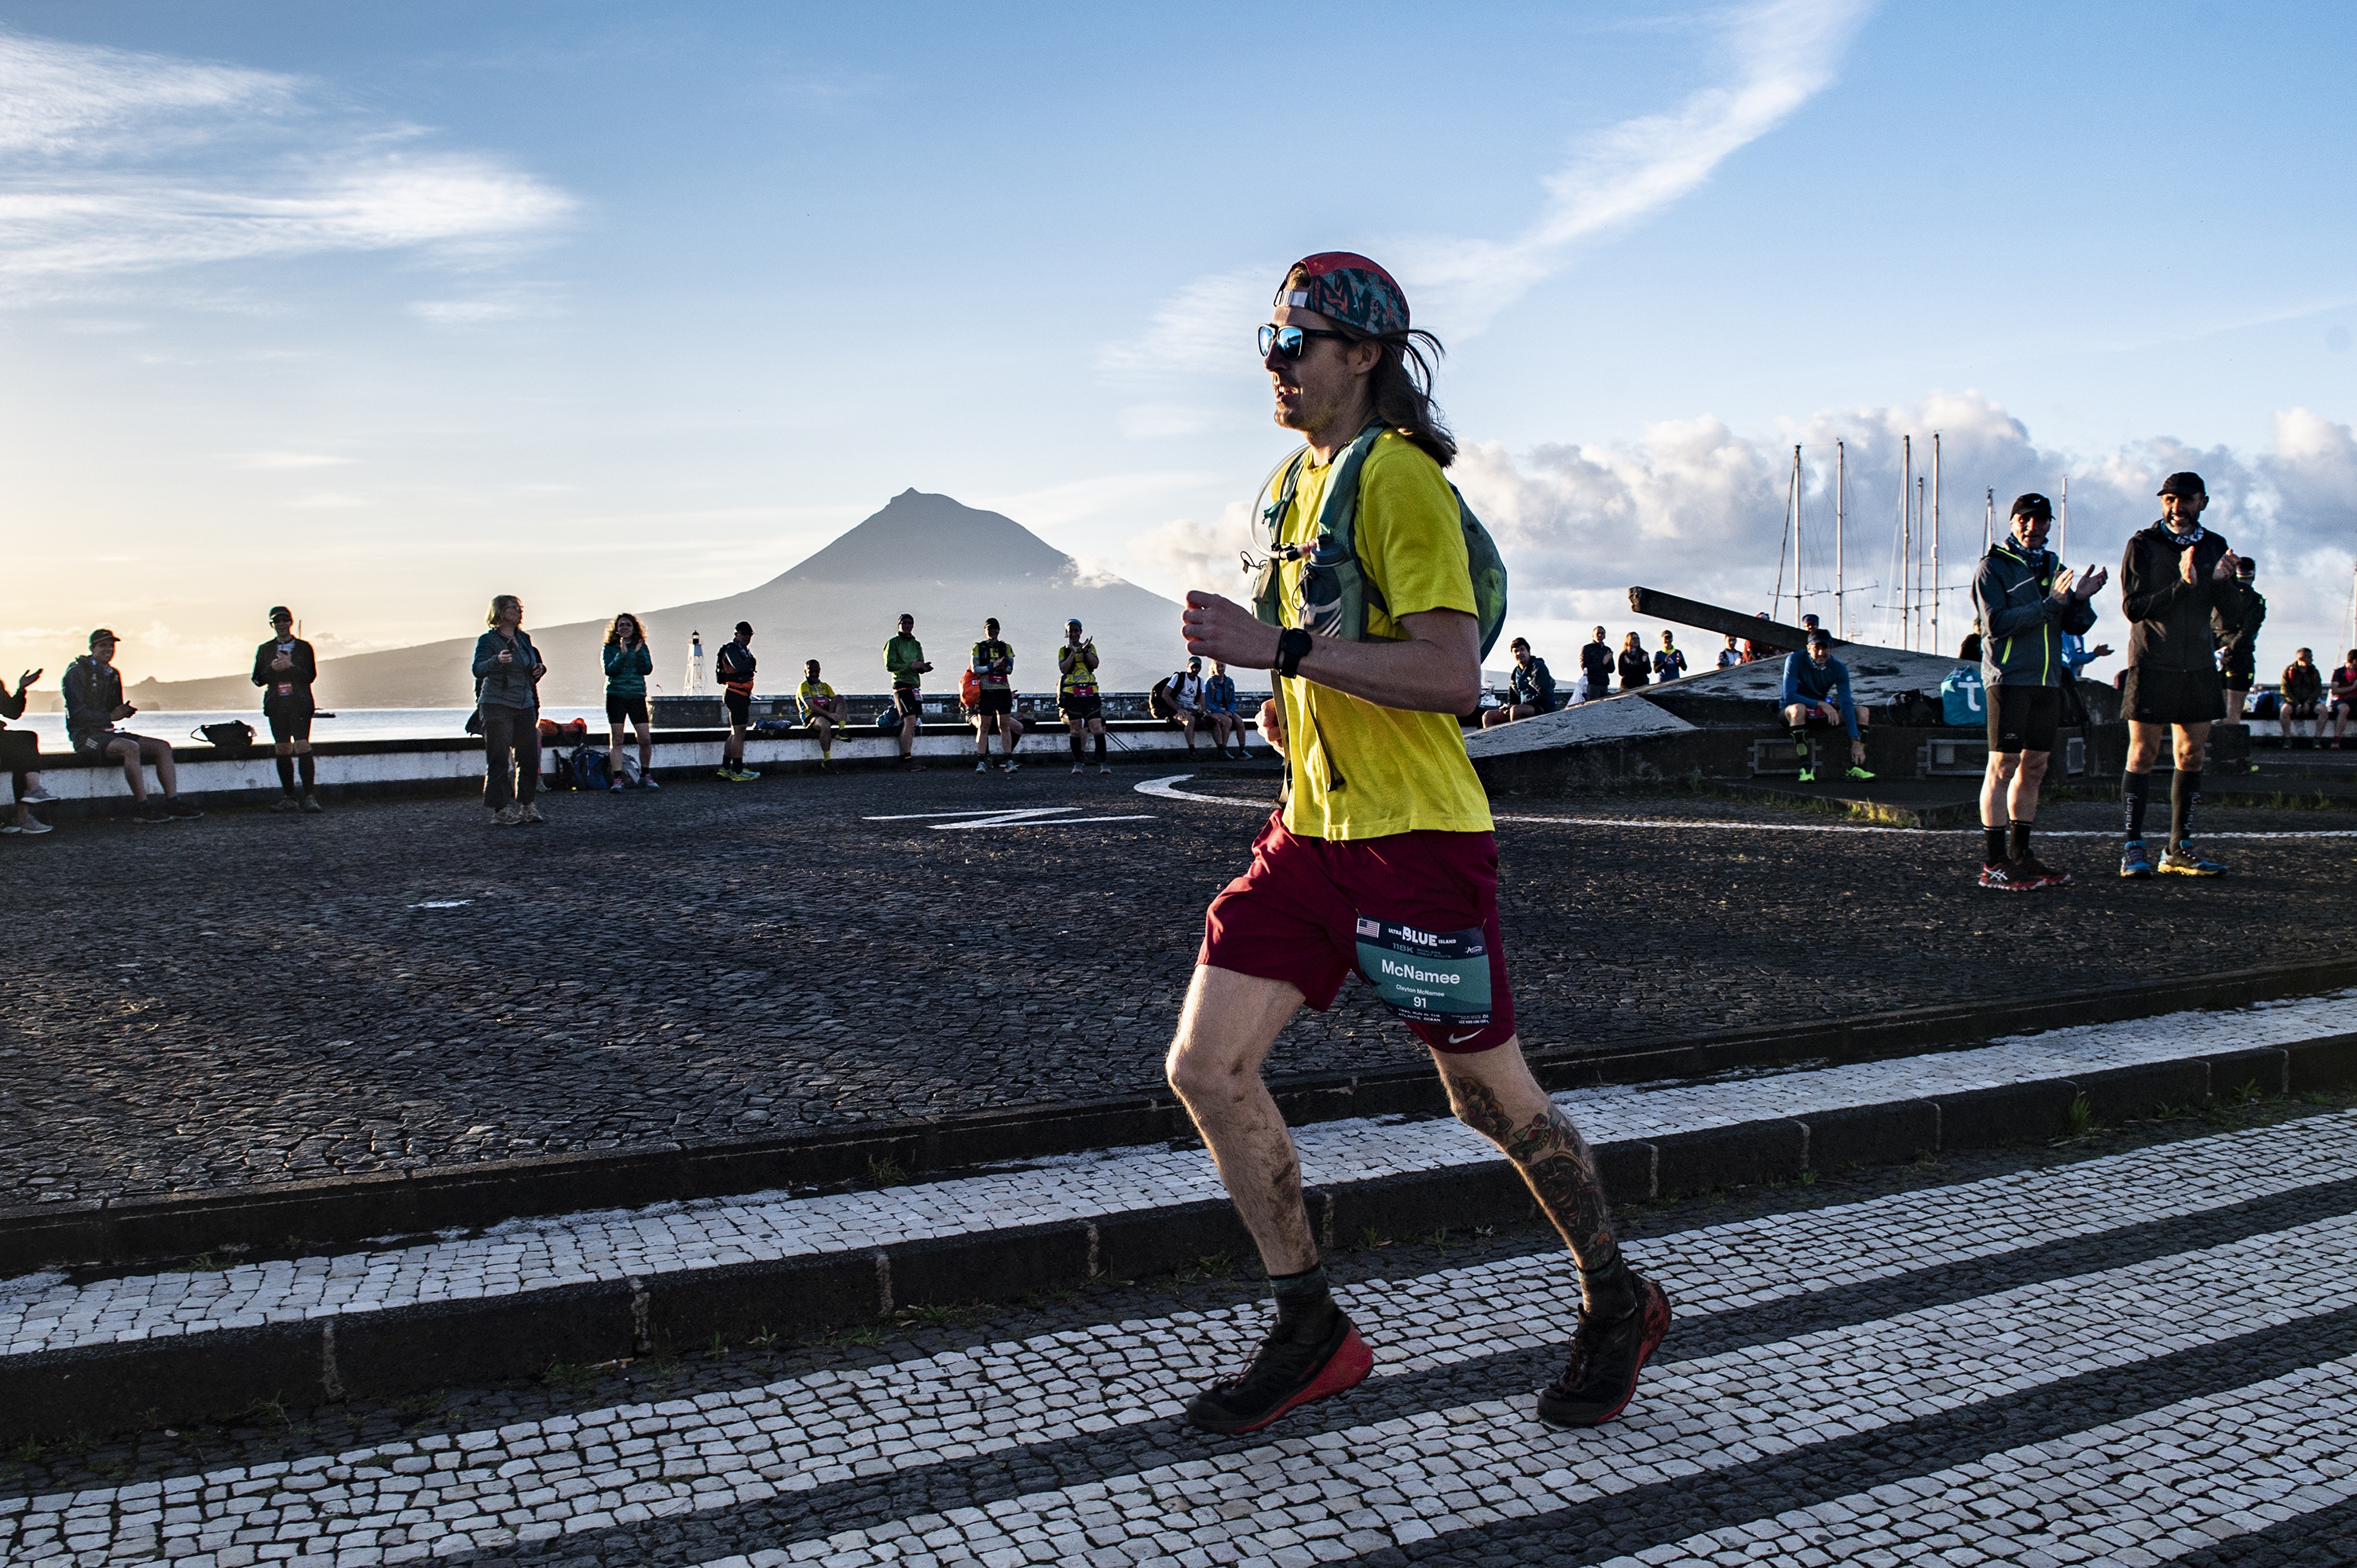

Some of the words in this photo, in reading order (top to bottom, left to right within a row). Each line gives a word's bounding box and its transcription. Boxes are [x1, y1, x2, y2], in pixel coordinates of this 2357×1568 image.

[1402, 926, 1438, 947] BLUE
[1393, 943, 1414, 954] 118K
[1381, 958, 1461, 984] McNamee
[1396, 984, 1416, 994] Clayton
[1417, 988, 1445, 997] McNamee
[1413, 996, 1427, 1008] 91
